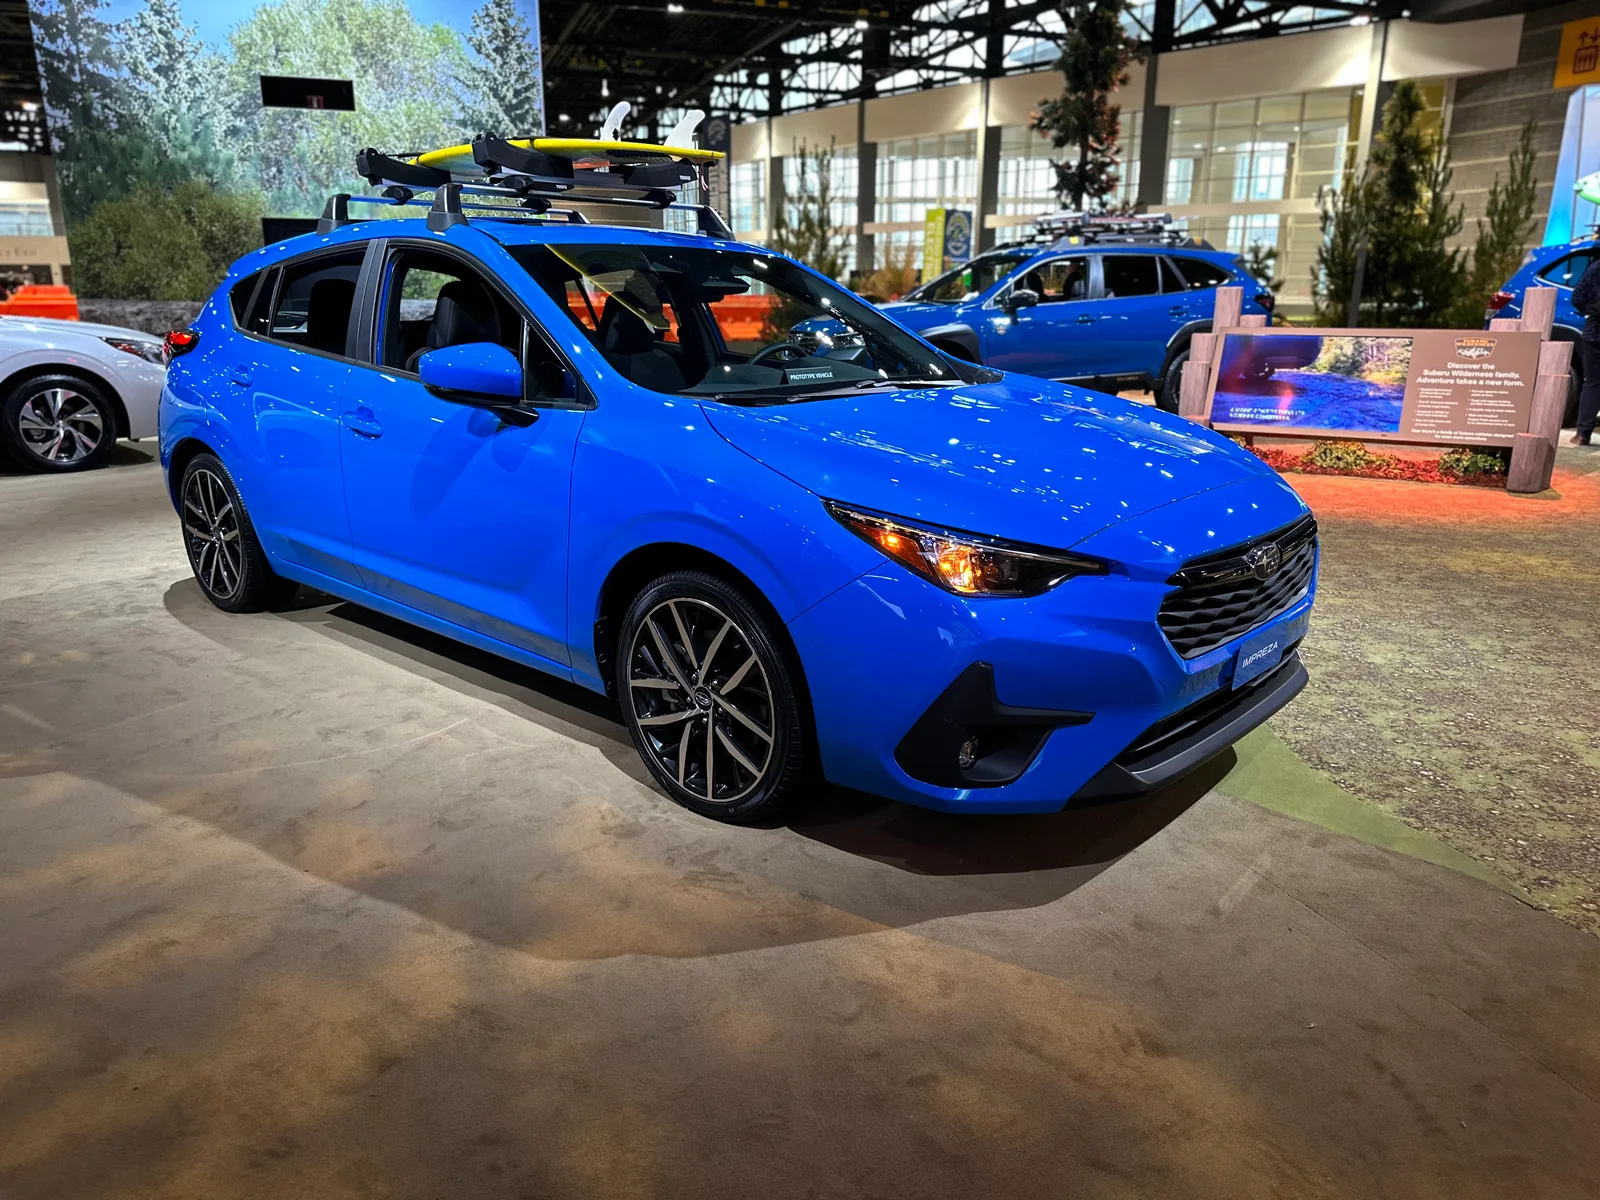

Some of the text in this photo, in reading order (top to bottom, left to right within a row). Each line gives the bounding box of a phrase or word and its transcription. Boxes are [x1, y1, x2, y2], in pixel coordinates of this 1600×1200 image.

[1451, 370, 1493, 378] Wilderness
[1495, 371, 1520, 379] family.
[1503, 379, 1524, 387] form.
[1242, 641, 1278, 668] IMPREZA
